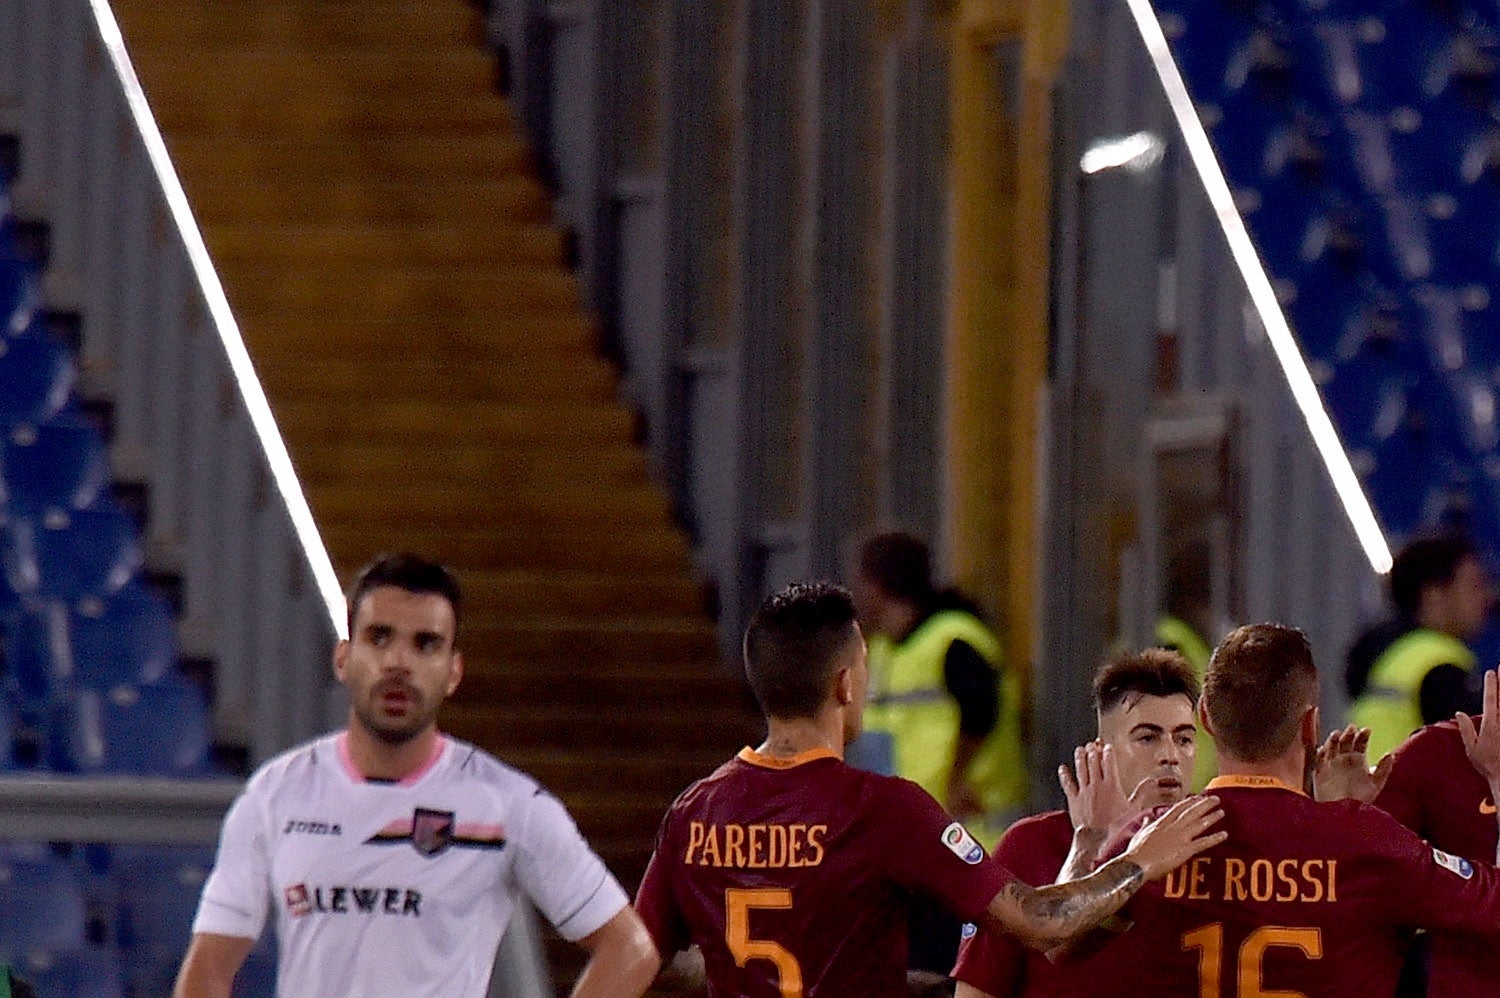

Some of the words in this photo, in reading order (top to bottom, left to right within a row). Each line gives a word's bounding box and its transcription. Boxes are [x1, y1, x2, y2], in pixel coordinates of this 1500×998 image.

[684, 821, 828, 869] PAREDES
[315, 887, 423, 917] LEWER
[1223, 858, 1338, 903] ROSSI
